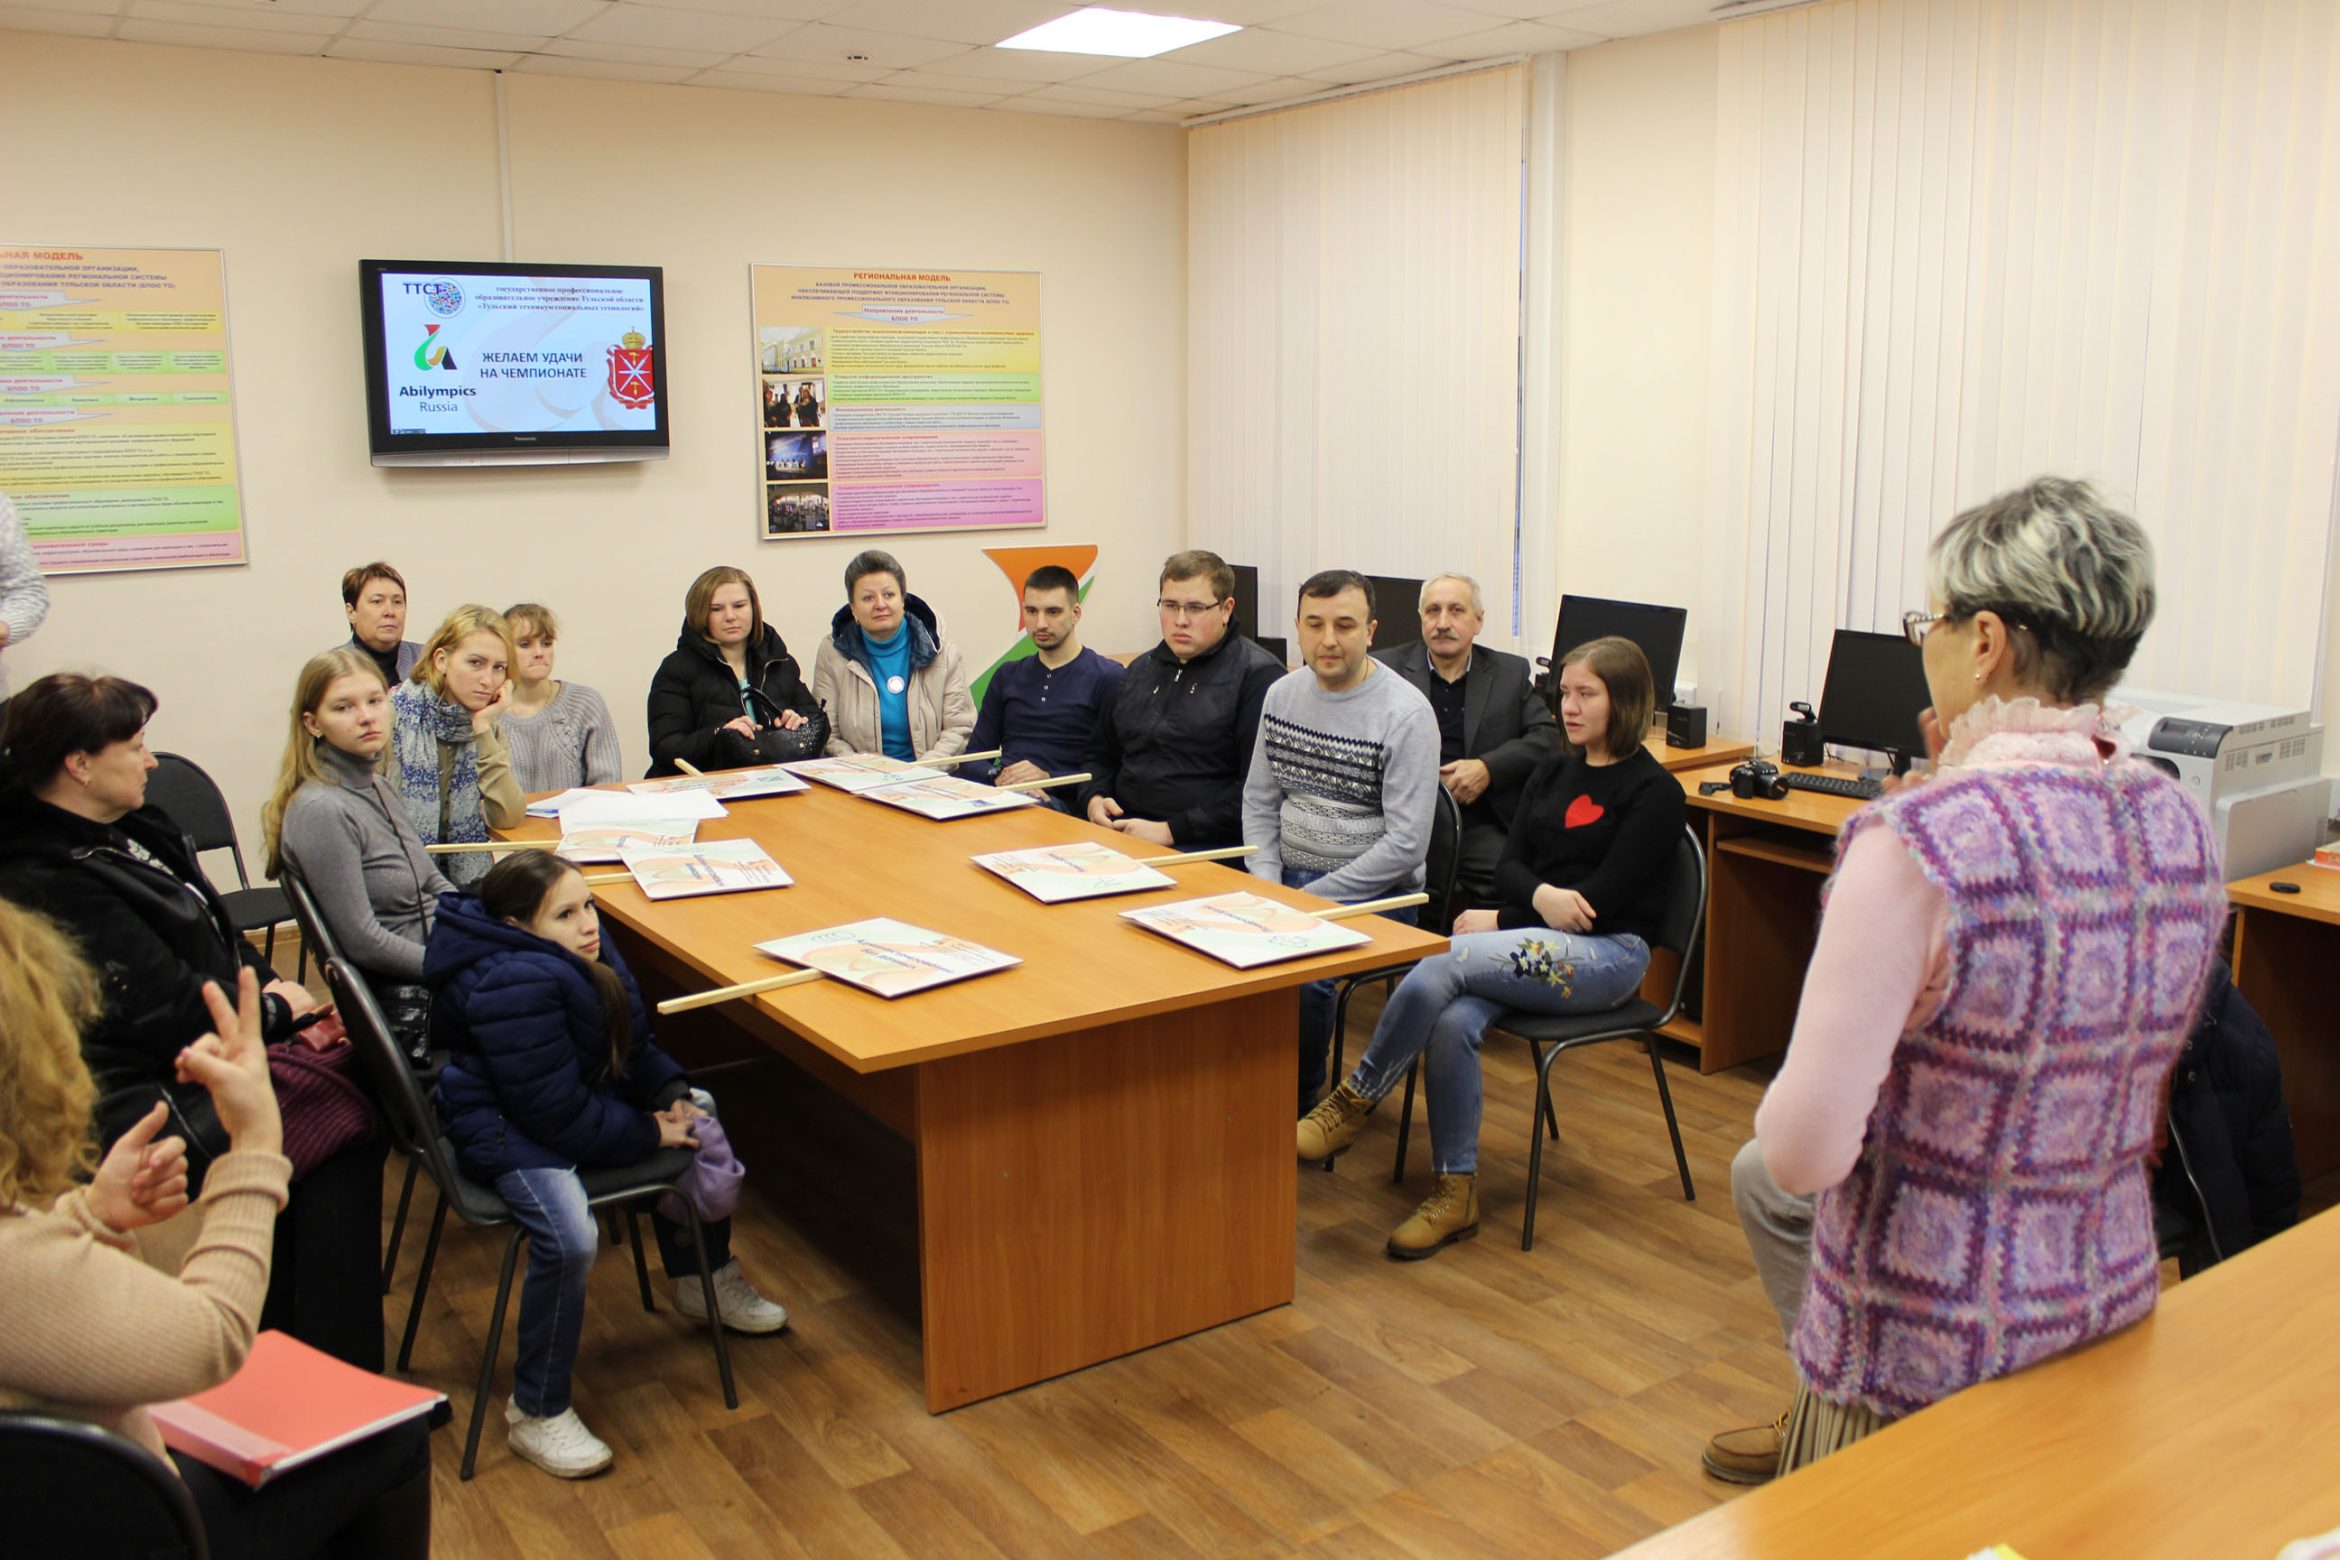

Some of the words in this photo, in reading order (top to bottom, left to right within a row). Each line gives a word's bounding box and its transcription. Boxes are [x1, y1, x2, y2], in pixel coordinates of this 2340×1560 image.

[33, 252, 84, 260] МОДЕЛЬ
[853, 272, 916, 281] РЕГИОНАЛЬНАЯ
[483, 353, 538, 362] ЖЕЛАЕМ
[542, 353, 582, 364] УДАЧИ
[481, 368, 498, 378] НА
[501, 368, 587, 378] ЧЕМПИОНАТЕ
[399, 386, 477, 398] Abilympics
[419, 402, 458, 412] Russia
